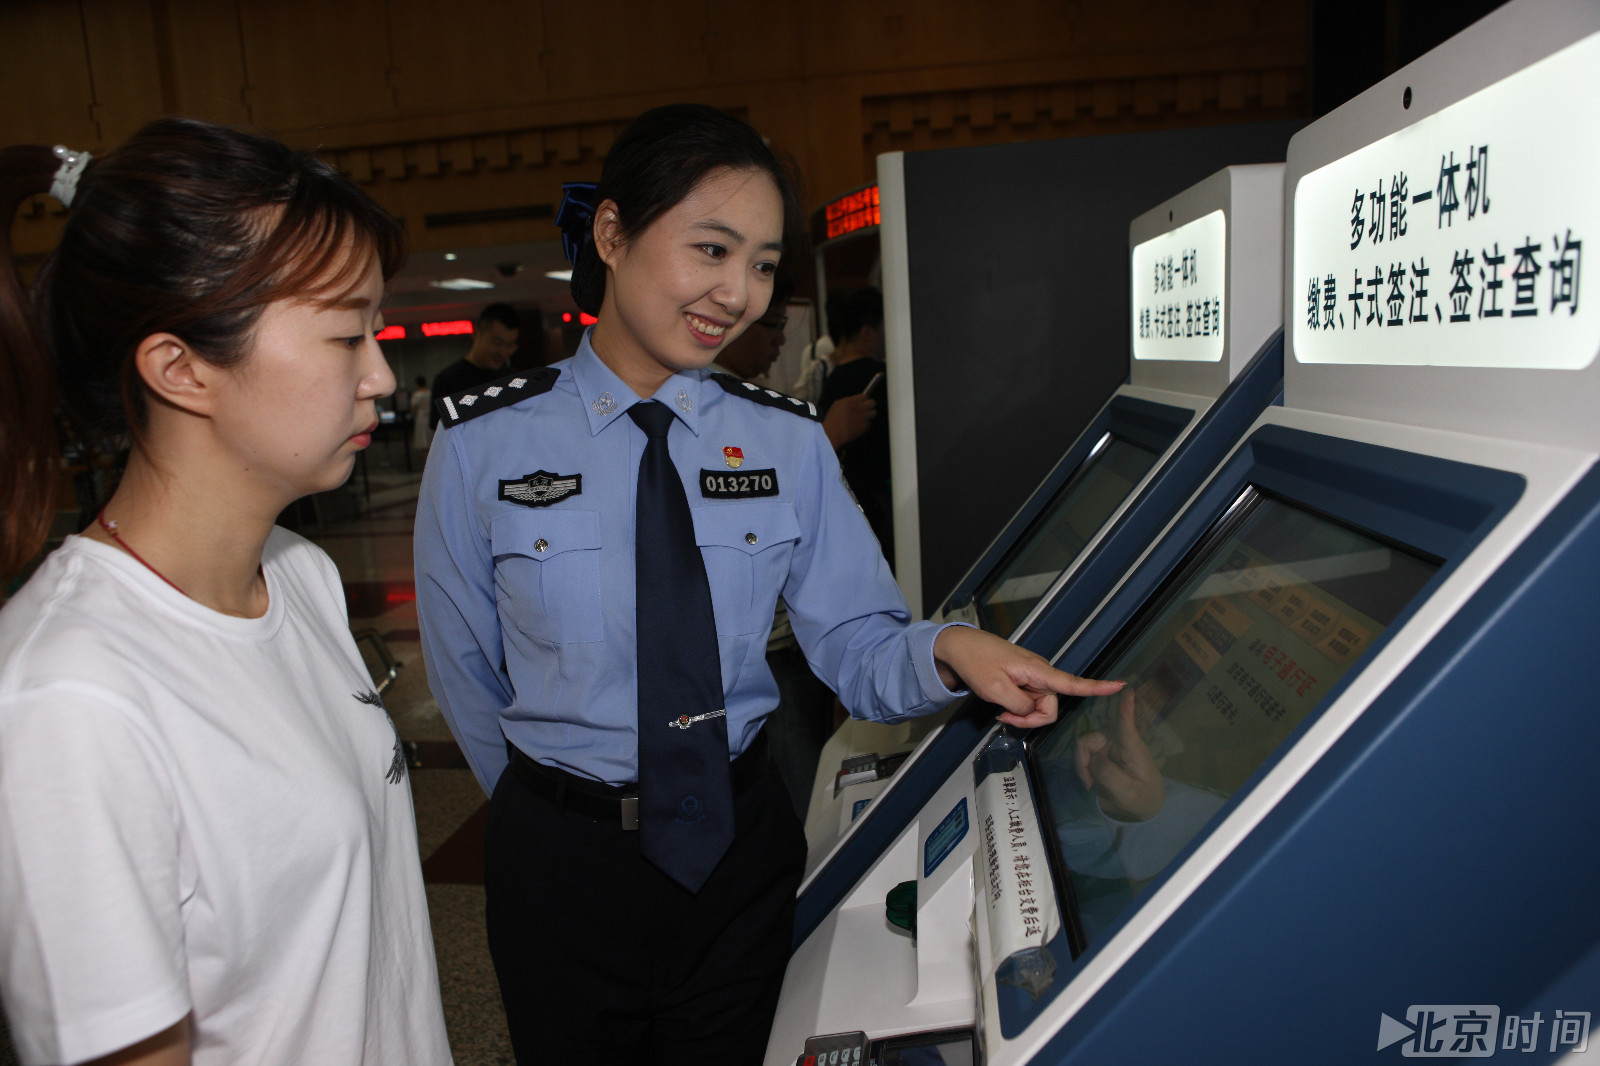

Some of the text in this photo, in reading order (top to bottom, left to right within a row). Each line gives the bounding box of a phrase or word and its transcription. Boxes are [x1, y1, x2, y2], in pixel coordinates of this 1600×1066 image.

[1350, 144, 1490, 250] 多功能一体机
[1307, 228, 1583, 331] 缴费、卡式签注、签注查询
[705, 474, 772, 492] 013270
